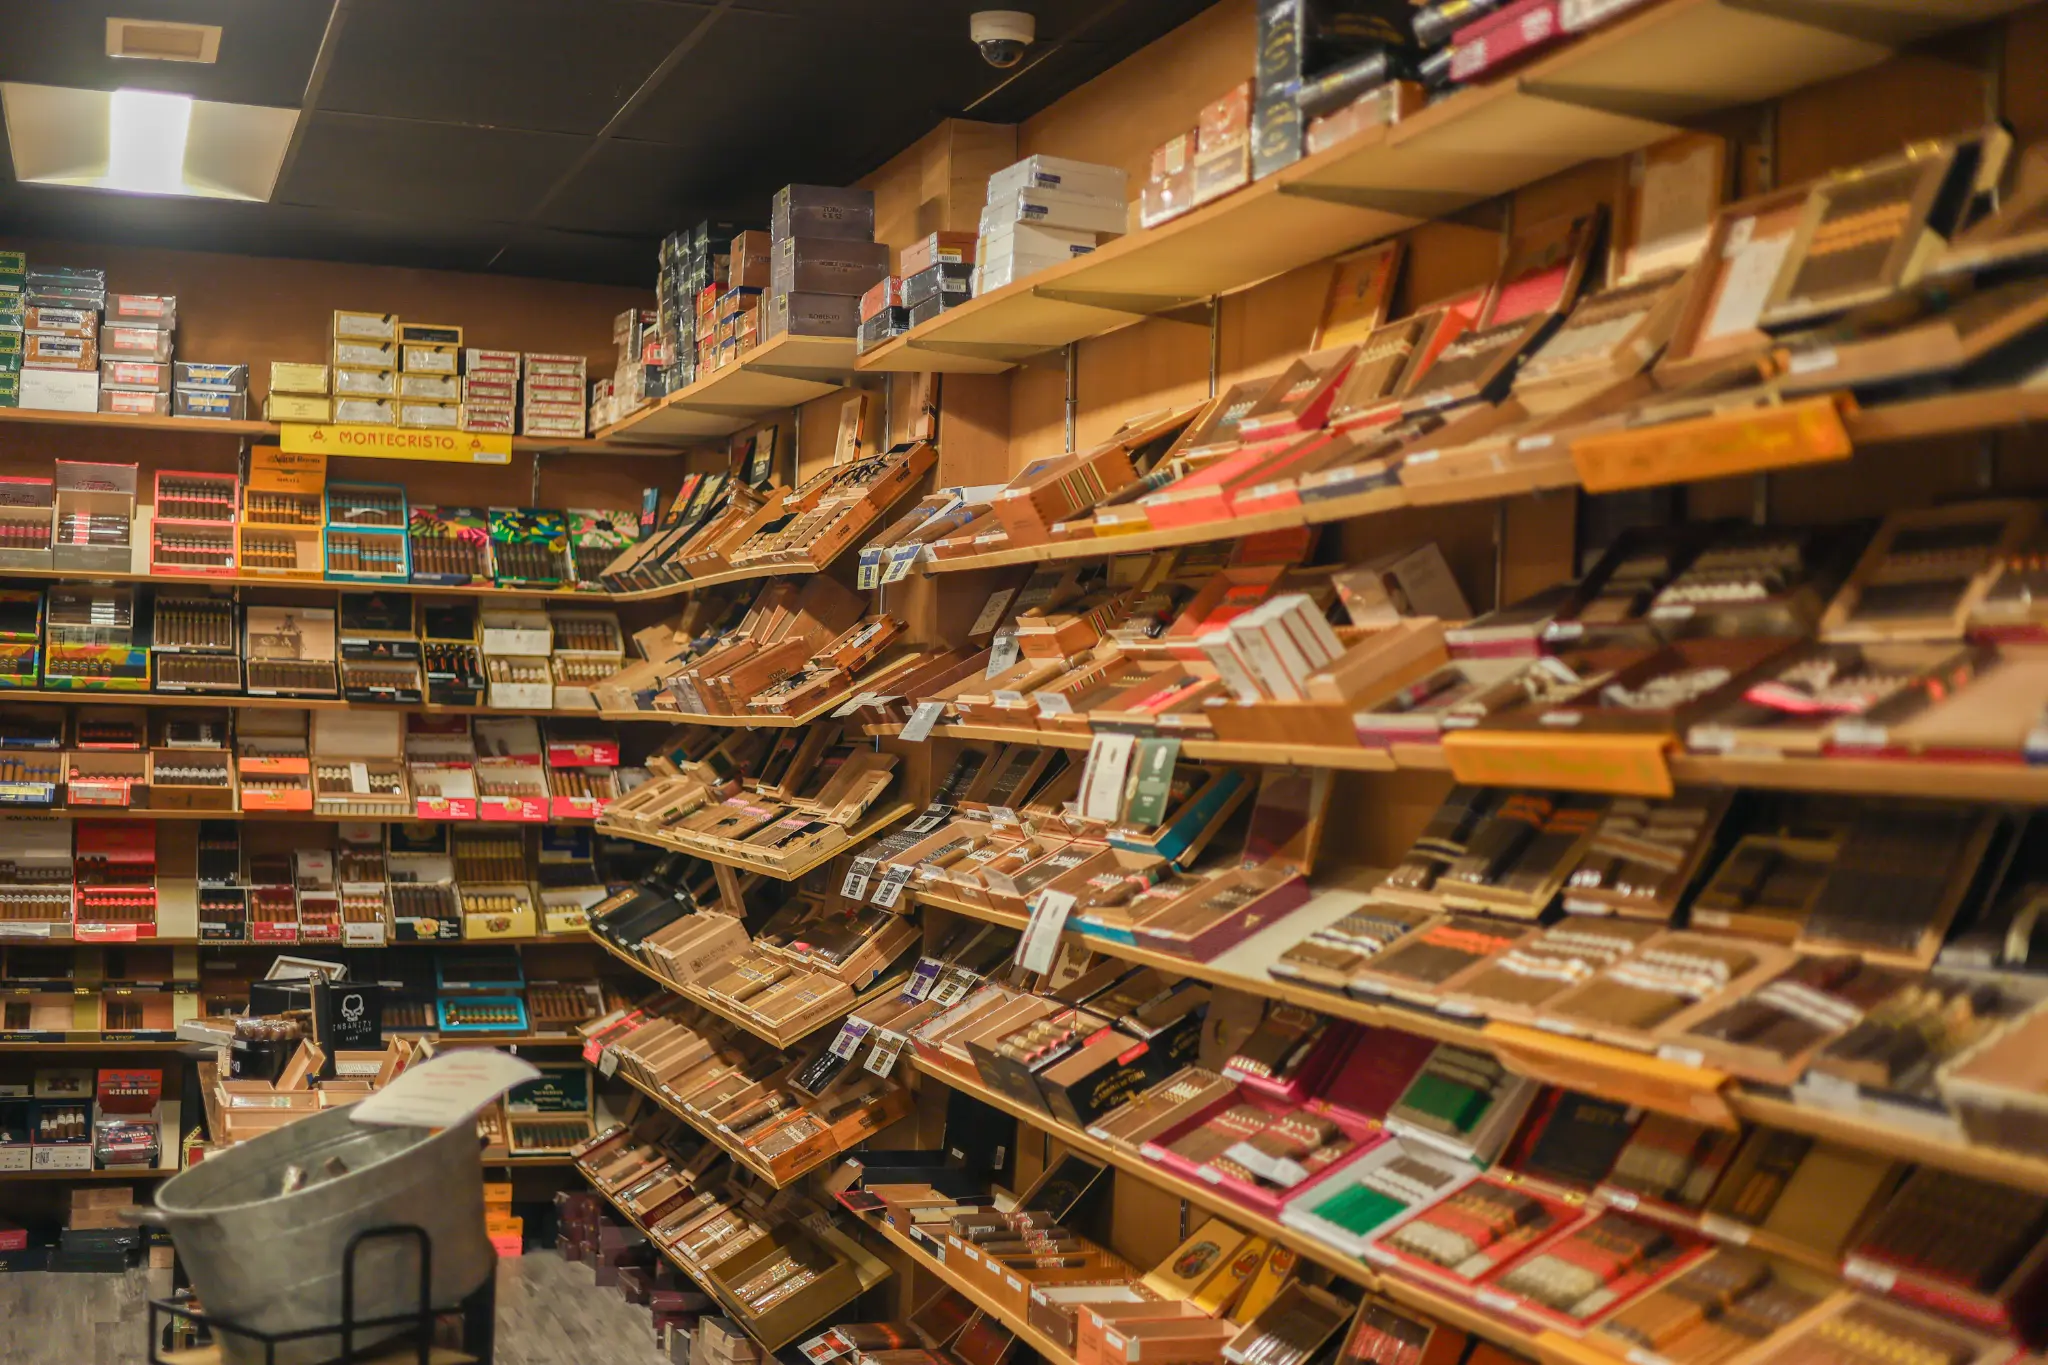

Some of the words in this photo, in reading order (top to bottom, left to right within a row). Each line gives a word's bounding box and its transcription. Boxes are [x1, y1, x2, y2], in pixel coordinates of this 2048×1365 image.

[338, 430, 456, 450] MONTECRISTO
[332, 1020, 372, 1032] INSANITY
[108, 1088, 149, 1096] WIENERS
